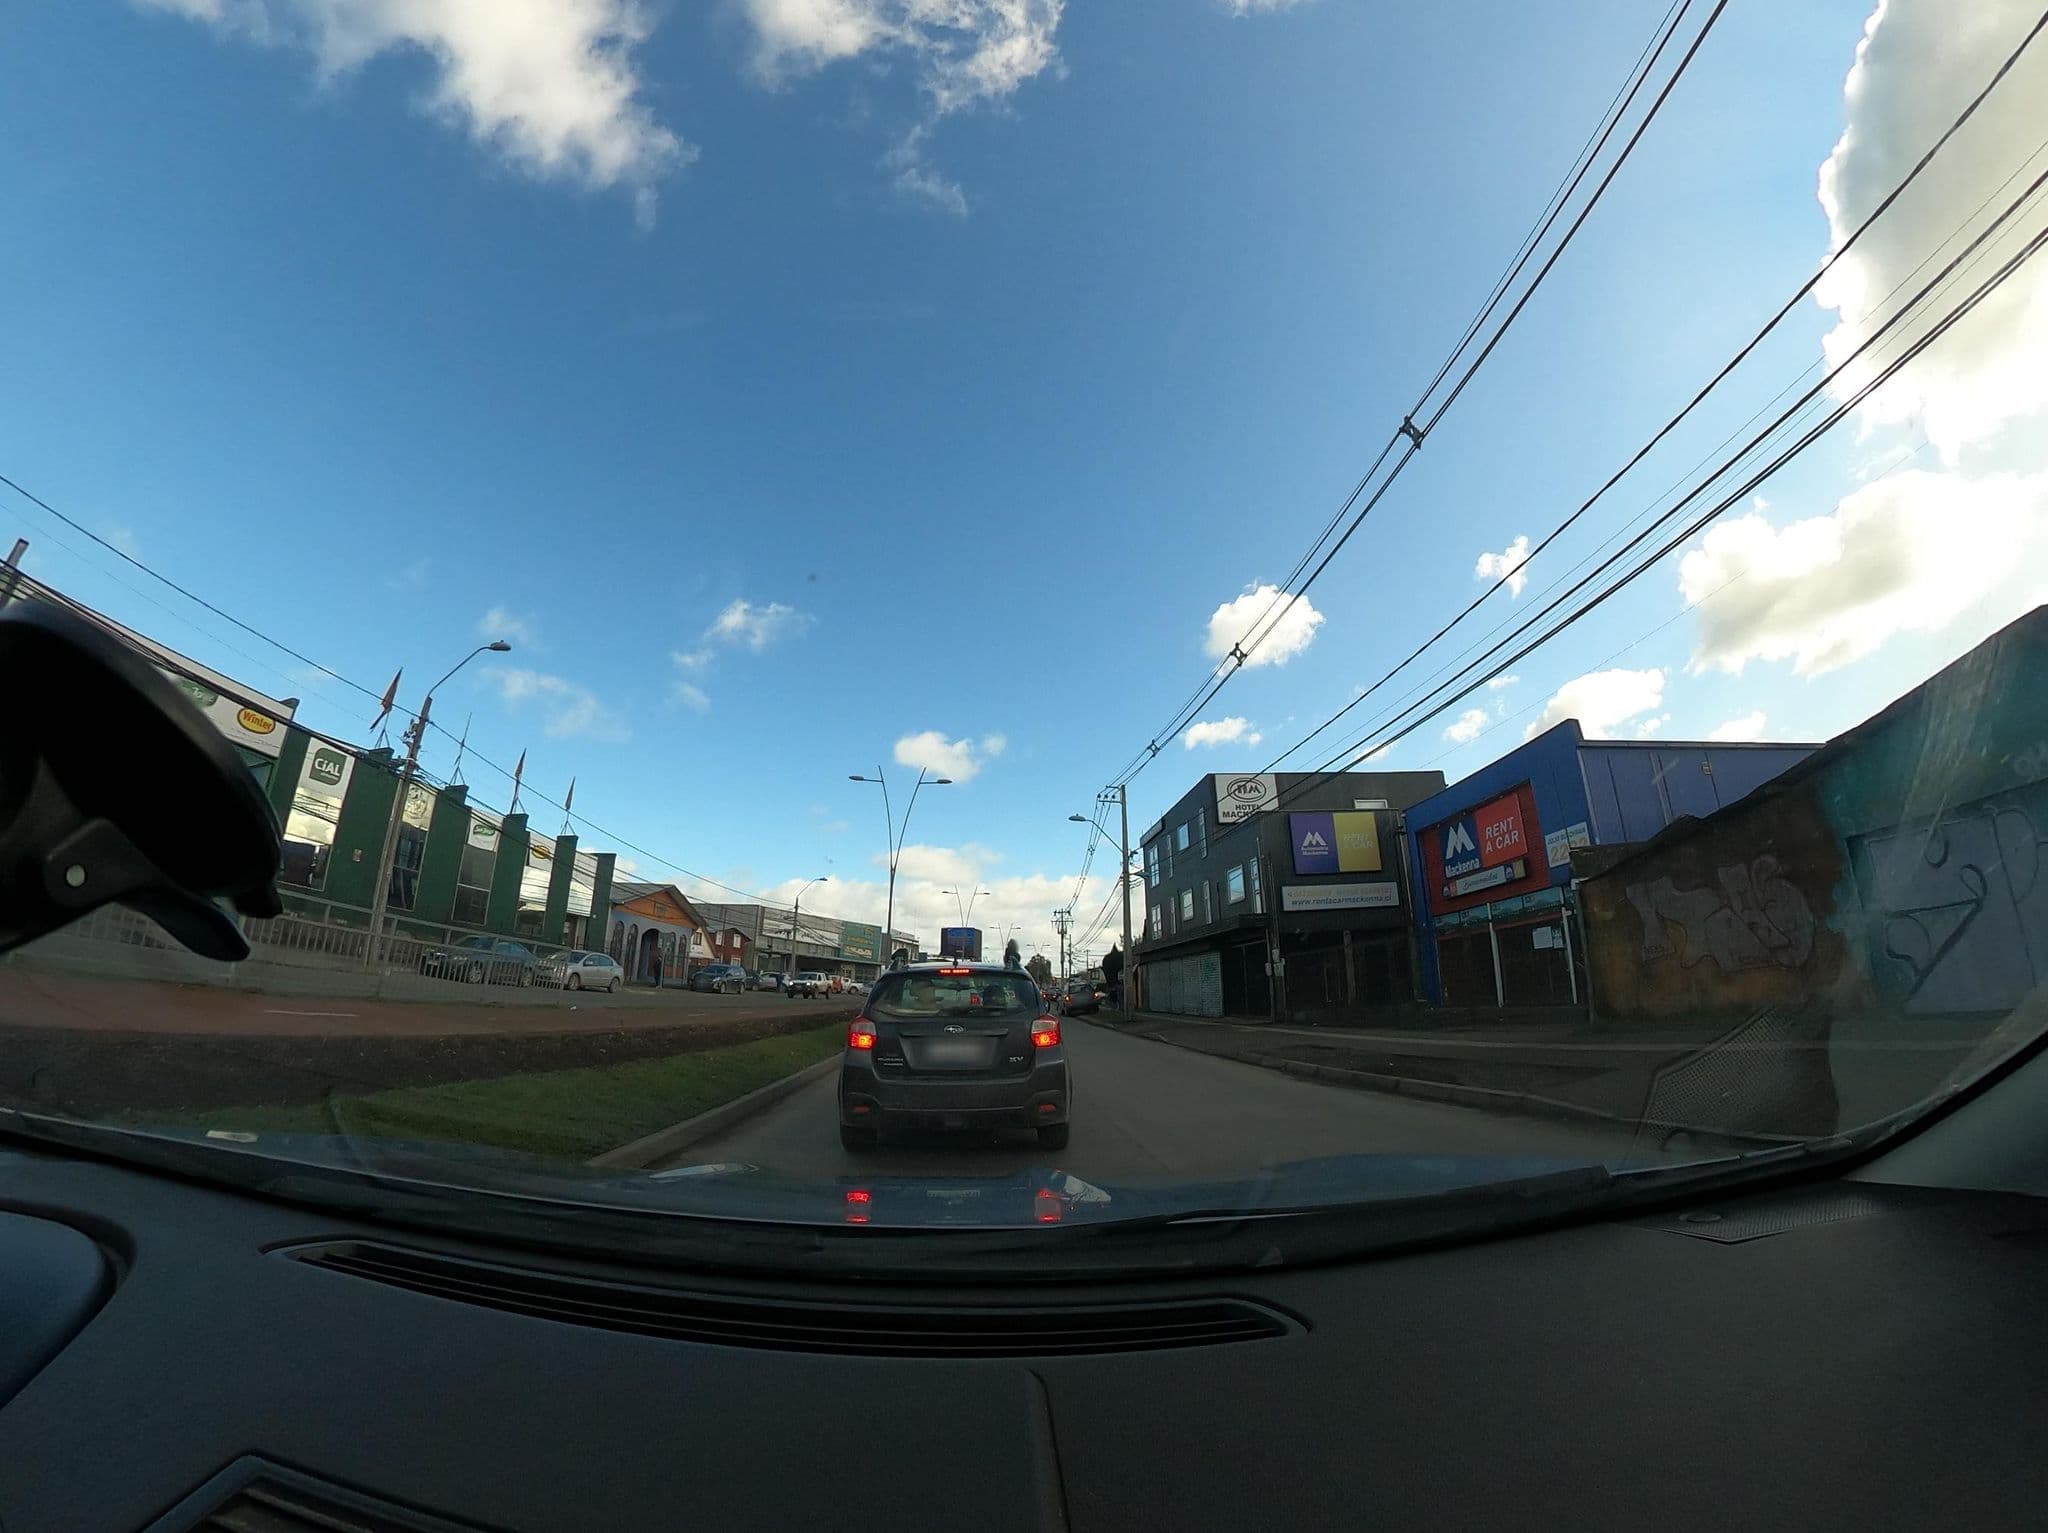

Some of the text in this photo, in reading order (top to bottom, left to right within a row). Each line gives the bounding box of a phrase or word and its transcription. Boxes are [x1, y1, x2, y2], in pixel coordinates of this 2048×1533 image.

[242, 710, 273, 730] Winter
[1485, 817, 1515, 840] RENT
[1486, 829, 1519, 855] A CAR
[1445, 858, 1480, 878] Mackenna
